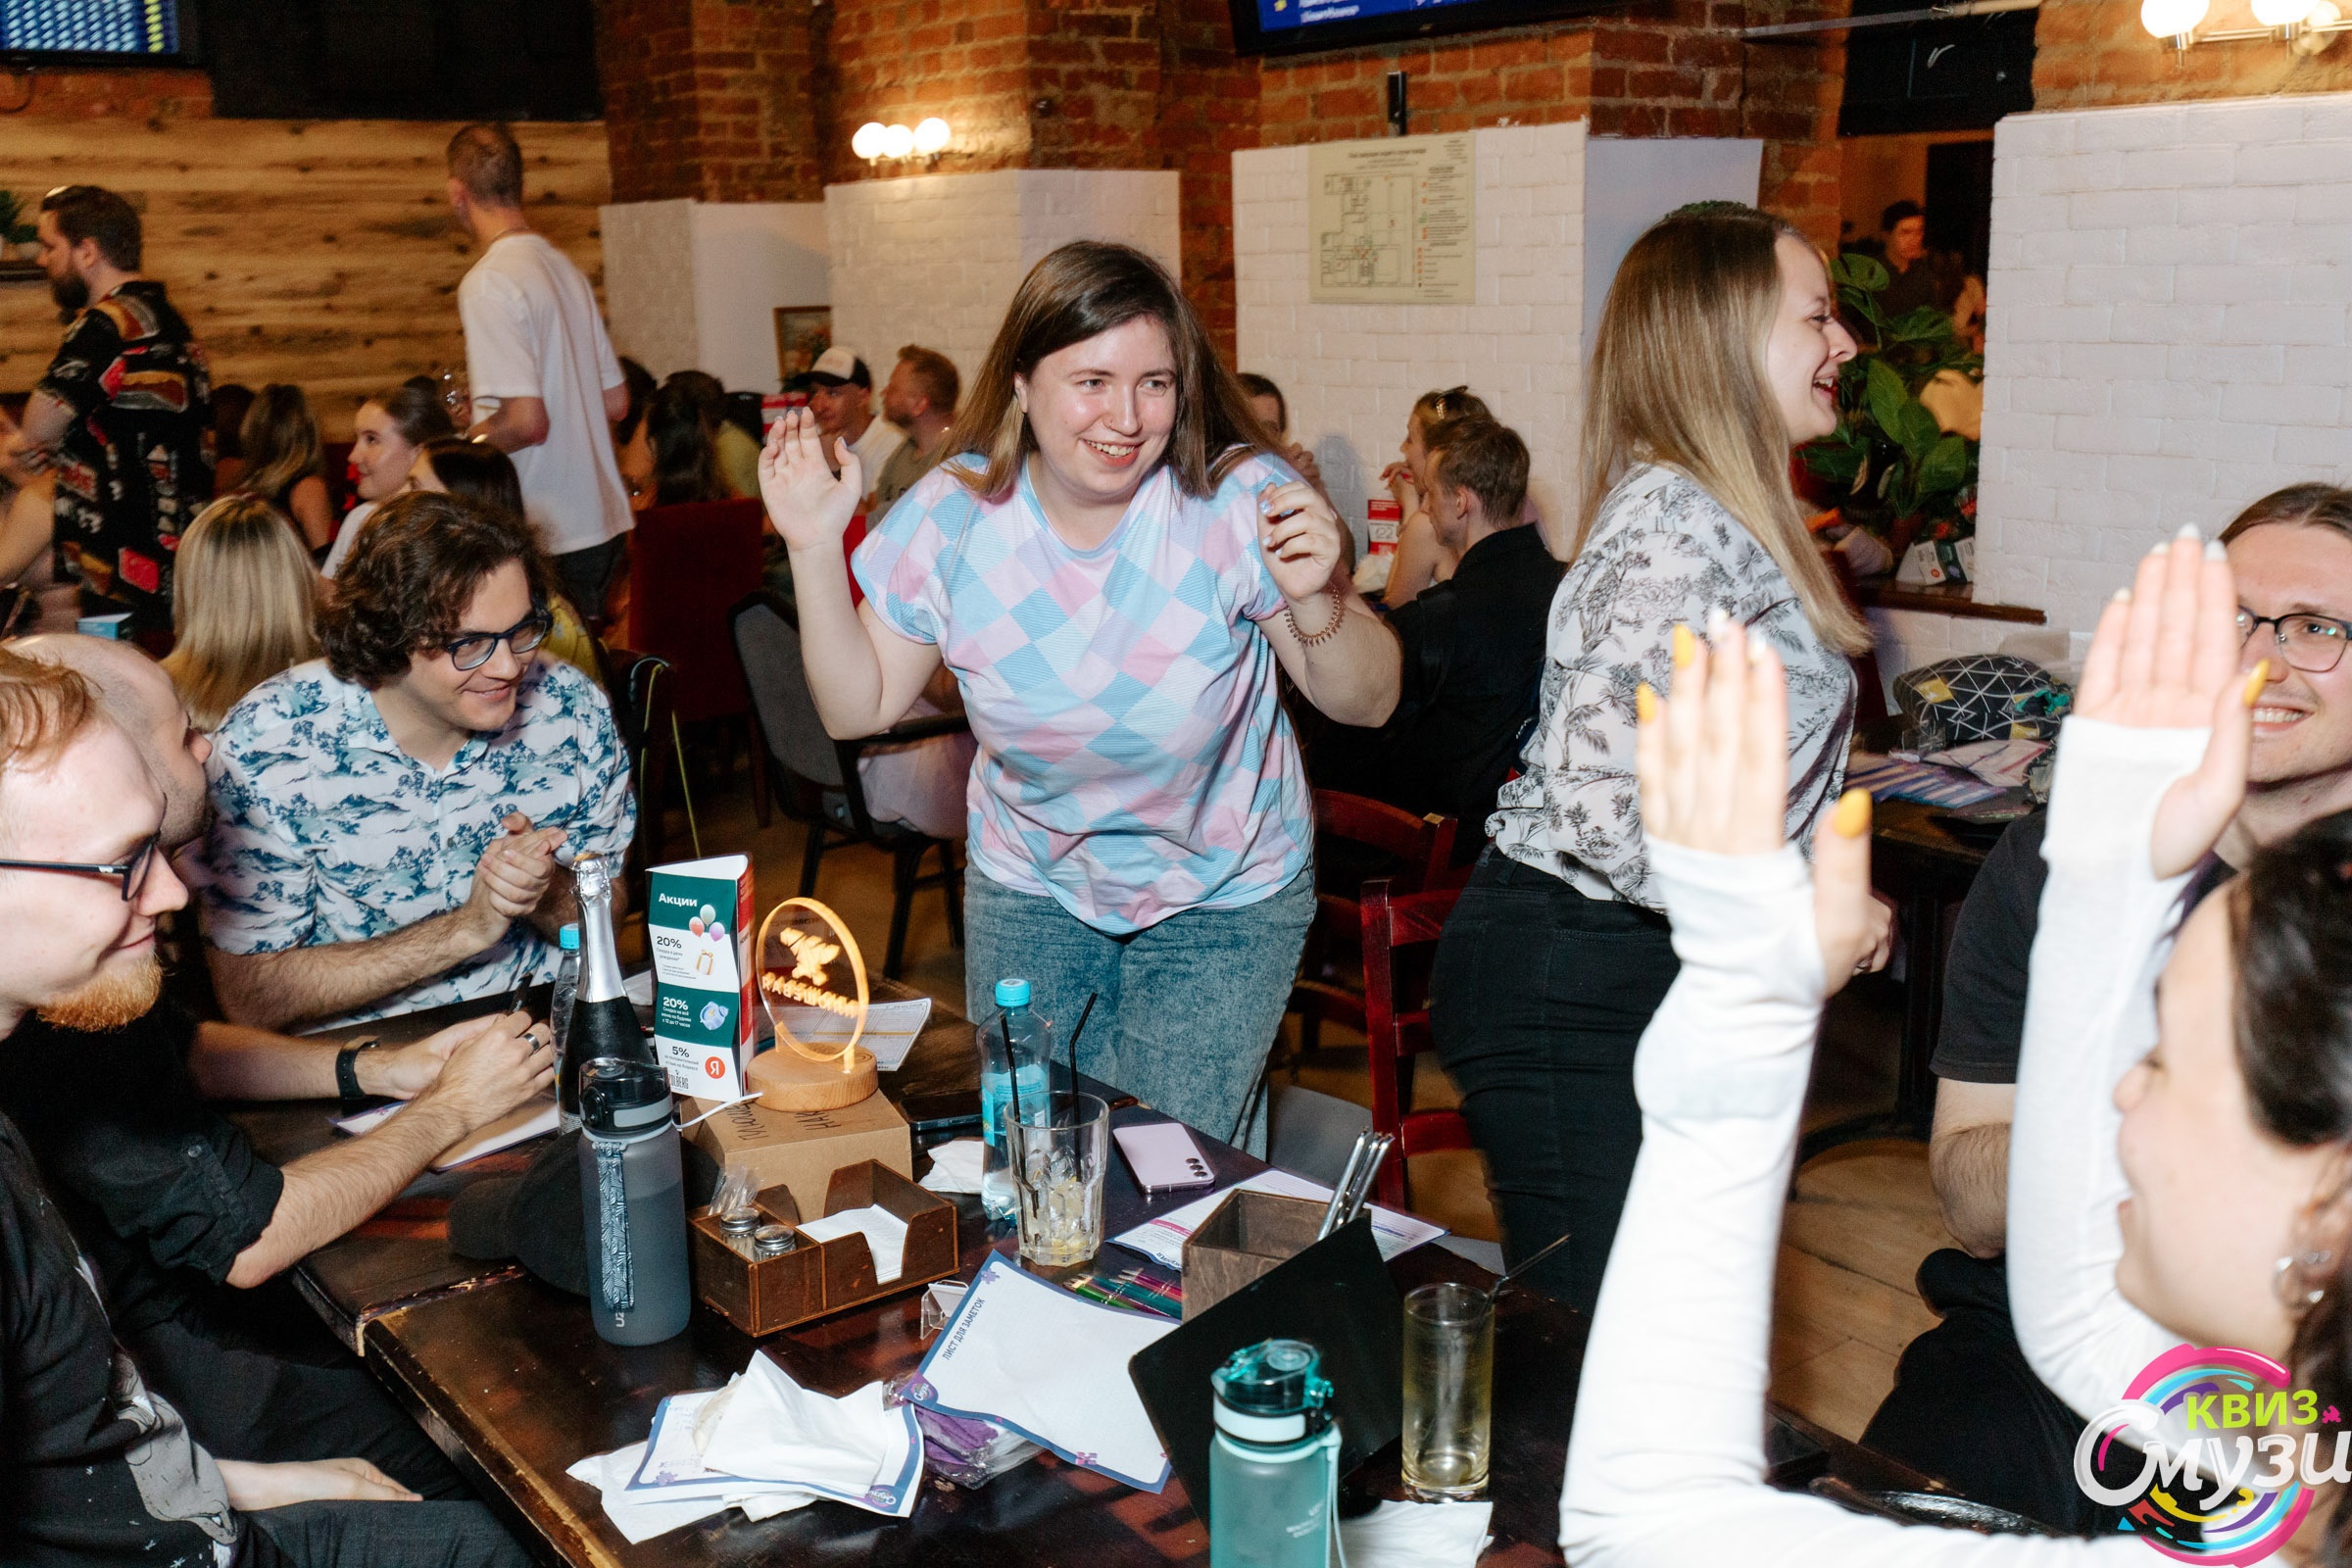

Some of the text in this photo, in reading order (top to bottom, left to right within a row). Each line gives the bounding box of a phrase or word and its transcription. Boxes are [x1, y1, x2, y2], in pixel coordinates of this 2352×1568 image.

[659, 893, 698, 906] Акции
[657, 936, 682, 949] 20%
[662, 997, 688, 1010] 20%
[671, 1046, 690, 1058] 5%
[710, 1060, 719, 1075] Я
[942, 1297, 986, 1360] ЛИСТ ДЛЯ ЗАМЕТОК
